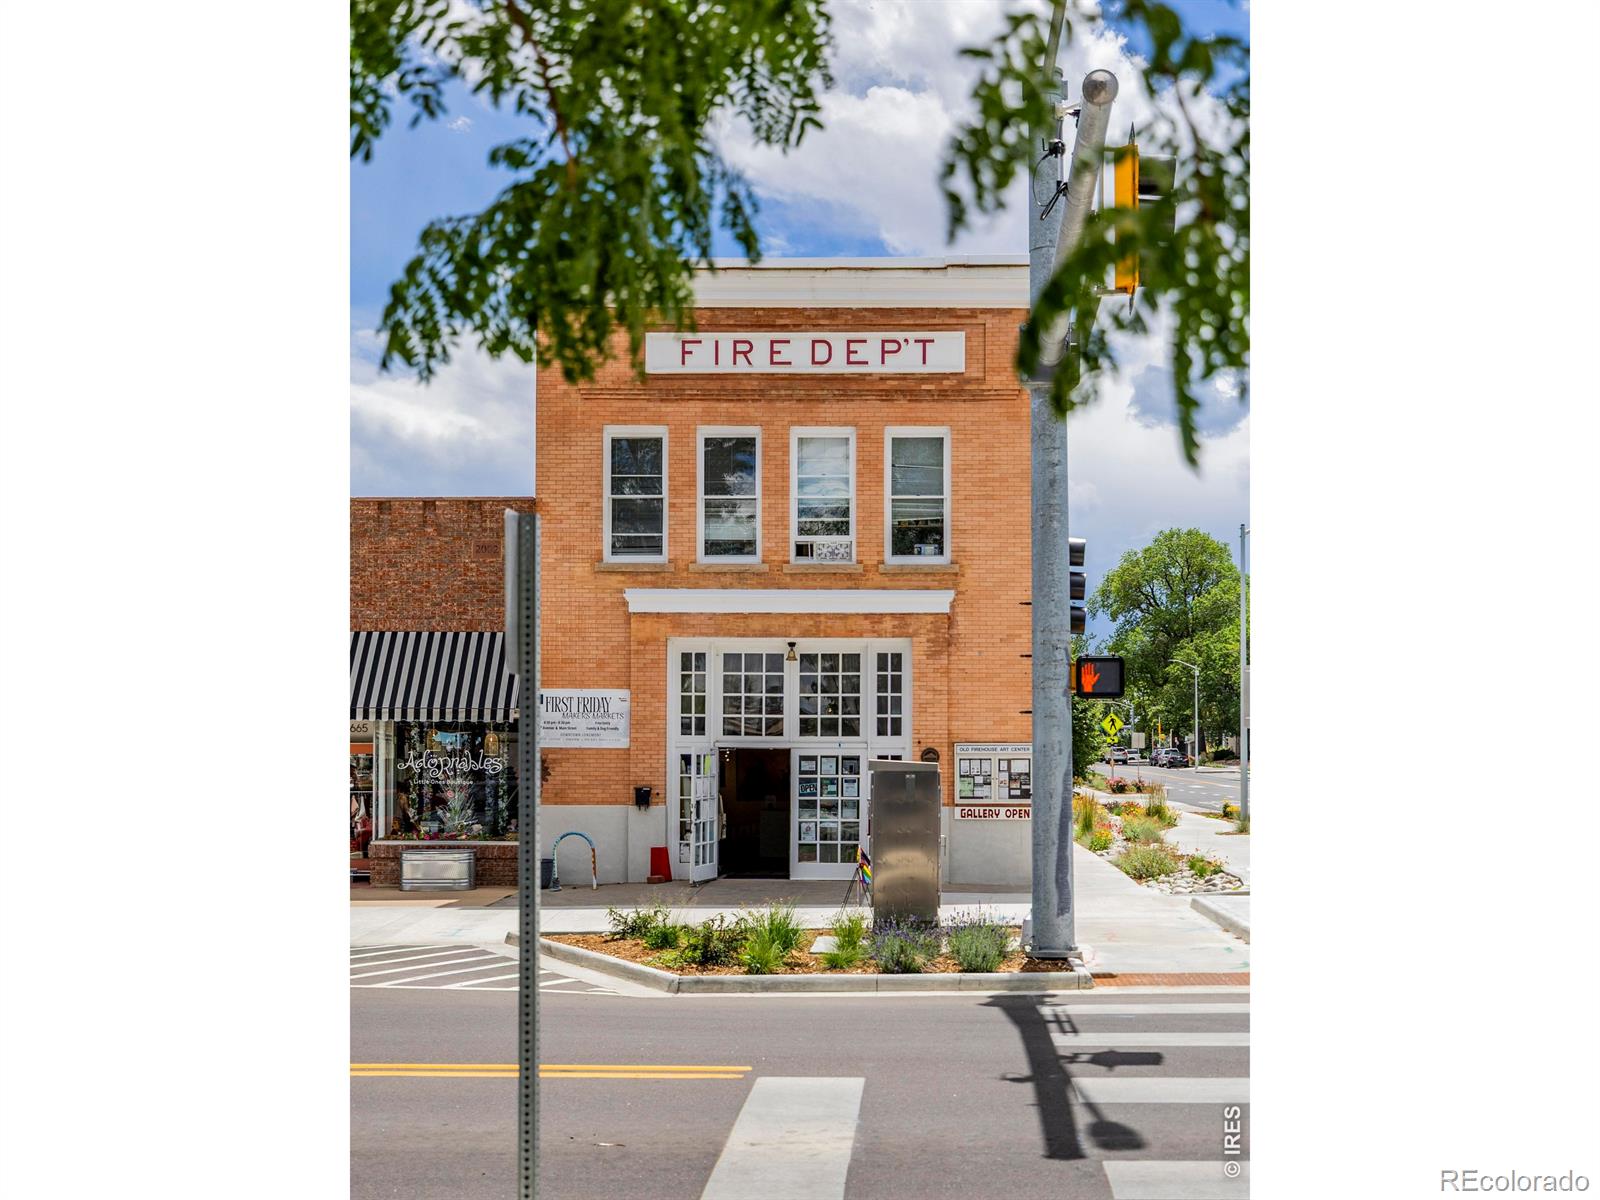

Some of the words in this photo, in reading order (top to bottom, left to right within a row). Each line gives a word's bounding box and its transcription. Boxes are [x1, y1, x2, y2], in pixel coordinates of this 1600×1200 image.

[681, 339, 793, 366] FIRE
[811, 338, 935, 366] DEP'T
[545, 696, 574, 713] FIRST
[577, 696, 612, 713] FRIDAY
[561, 712, 591, 720] MAKERS
[592, 712, 625, 720] MARKETS
[350, 723, 369, 733] 665
[397, 750, 504, 778] Adornables
[800, 783, 817, 793] OPEN
[960, 808, 1000, 819] GALLERY
[1004, 808, 1030, 819] OPEN
